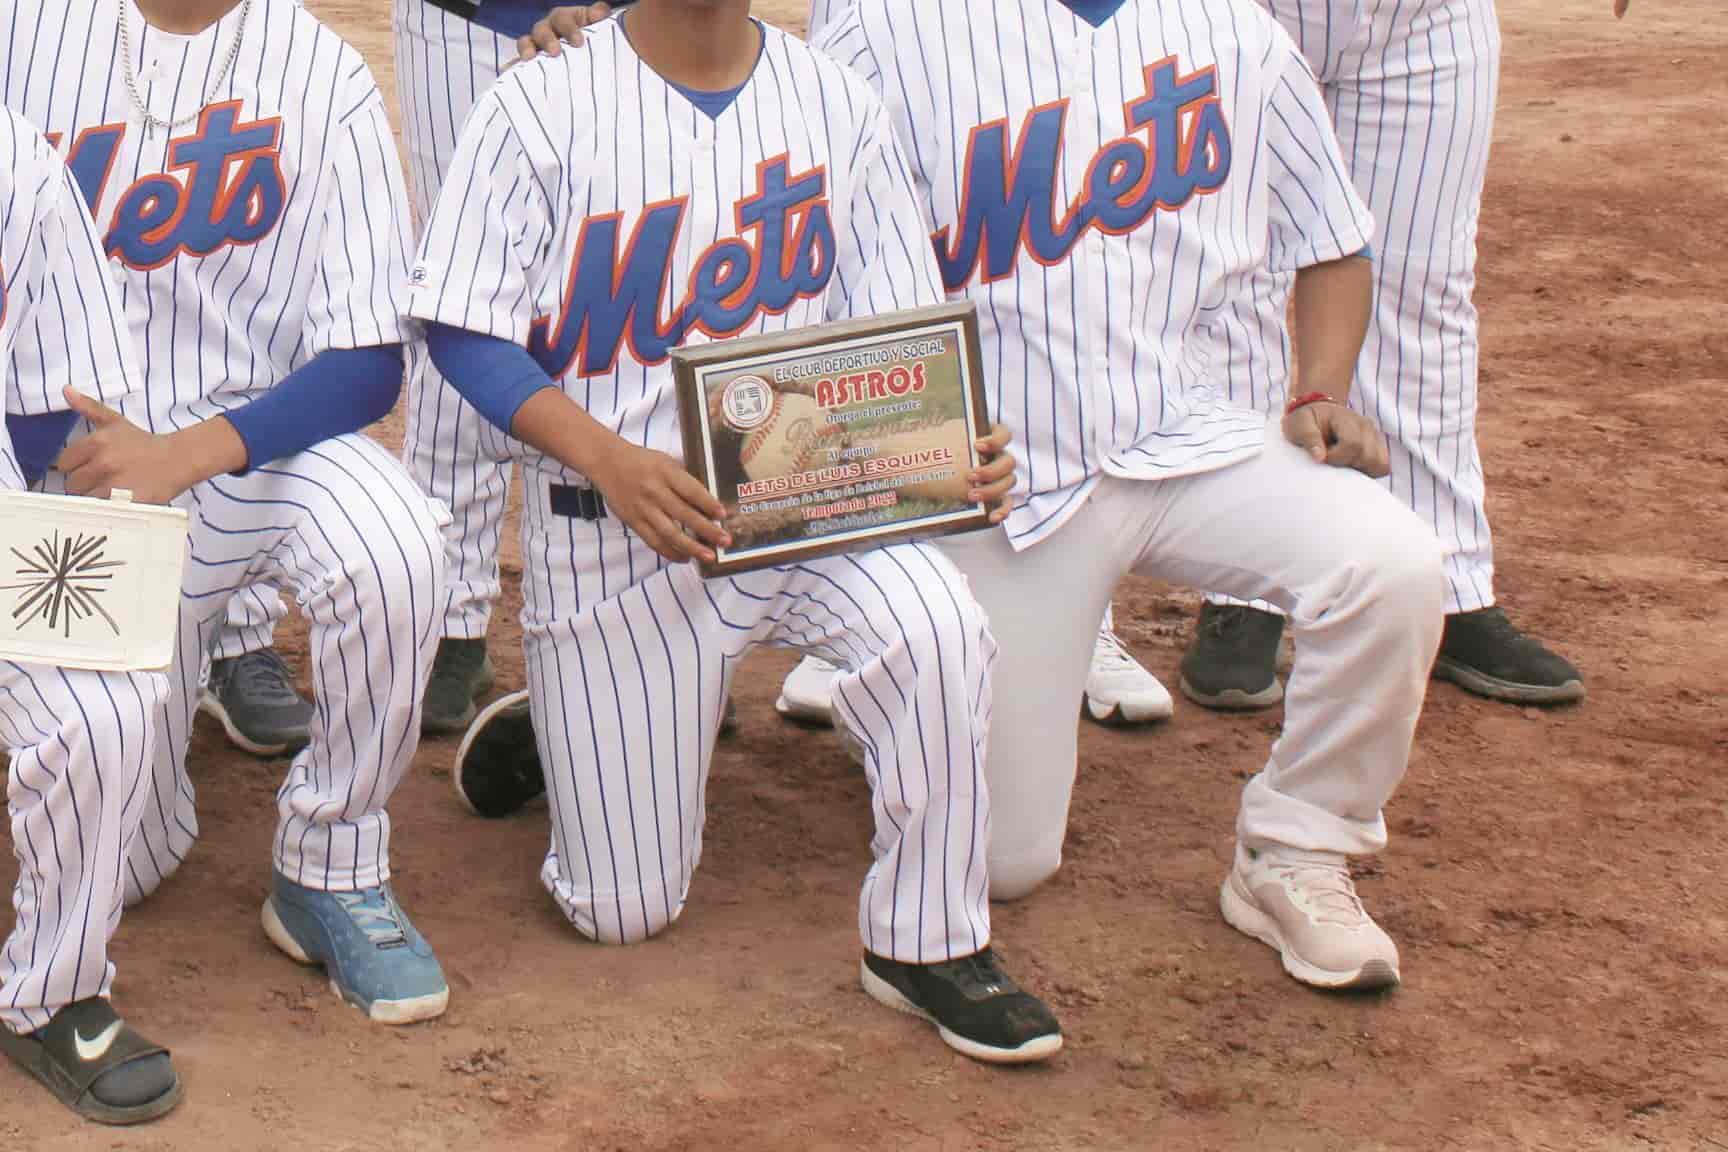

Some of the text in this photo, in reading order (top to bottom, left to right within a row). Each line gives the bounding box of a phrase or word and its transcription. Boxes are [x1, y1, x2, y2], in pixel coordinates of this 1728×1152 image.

[930, 54, 1232, 292] Mets
[528, 151, 837, 379] Mets
[791, 361, 821, 378] CLUB
[903, 339, 945, 359] SOCIAL
[815, 361, 927, 409] ASTROS
[737, 478, 788, 497] METS
[791, 471, 817, 487] DE
[819, 463, 862, 482] LUIS
[863, 448, 953, 475] ESQUIVEL
